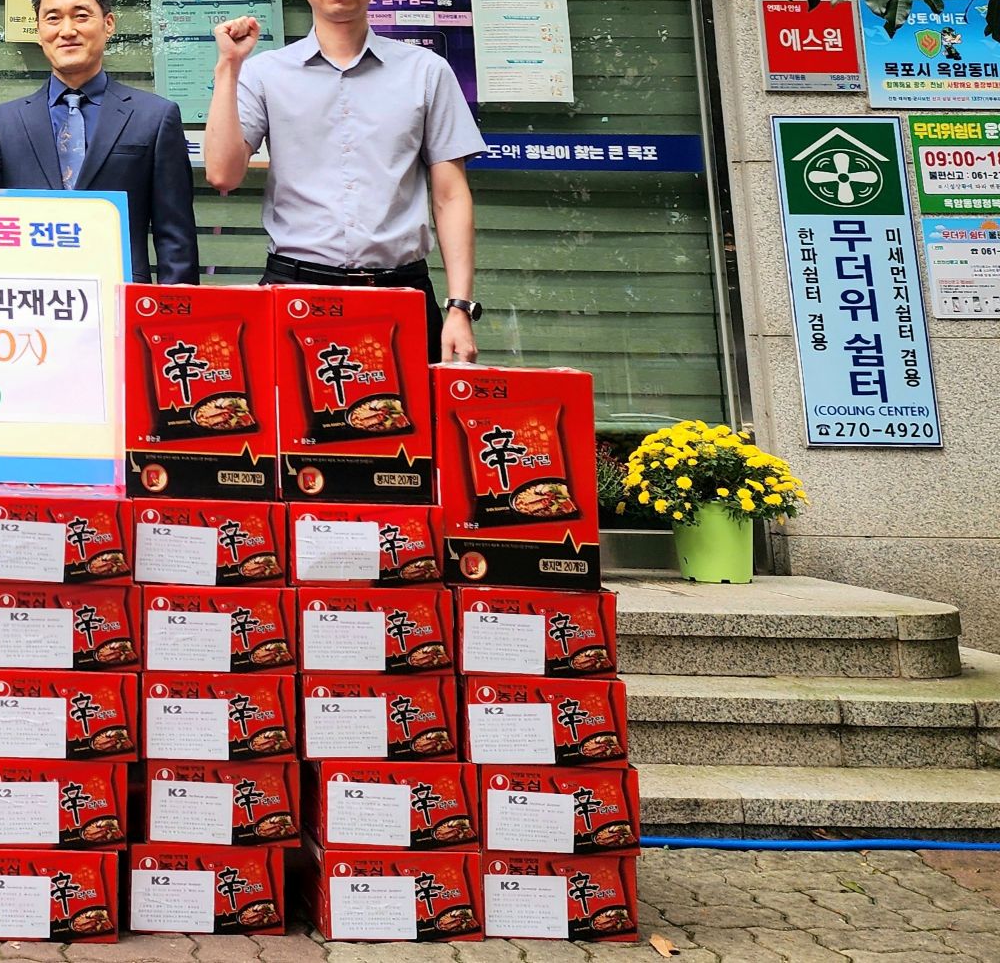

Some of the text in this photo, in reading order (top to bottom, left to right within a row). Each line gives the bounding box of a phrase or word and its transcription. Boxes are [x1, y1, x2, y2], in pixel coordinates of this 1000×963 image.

[779, 28, 844, 52] 에스원
[885, 63, 931, 77] 목포시
[913, 122, 982, 140] 무더위쉼터
[488, 144, 658, 161] 도약! 청년이 찾는 큰 목포
[929, 171, 964, 180] 불편신고
[28, 221, 82, 248] 전달
[797, 227, 829, 351] 한파쉼터 겸용
[158, 302, 192, 316] 농심
[310, 303, 344, 317] 농심
[885, 228, 921, 387] 미세먼지쉼터 겸용
[473, 385, 508, 399] 농심
[813, 404, 930, 418] (COOLING CENTER)
[834, 422, 934, 438] 270-4920
[168, 616, 186, 624] K2
[480, 615, 498, 623] K2
[322, 704, 340, 712] K2
[169, 789, 186, 797] K2
[345, 790, 363, 798] K2
[509, 796, 527, 804] K2
[152, 877, 169, 885] K2
[351, 884, 369, 892] K2
[501, 882, 519, 890] K2
